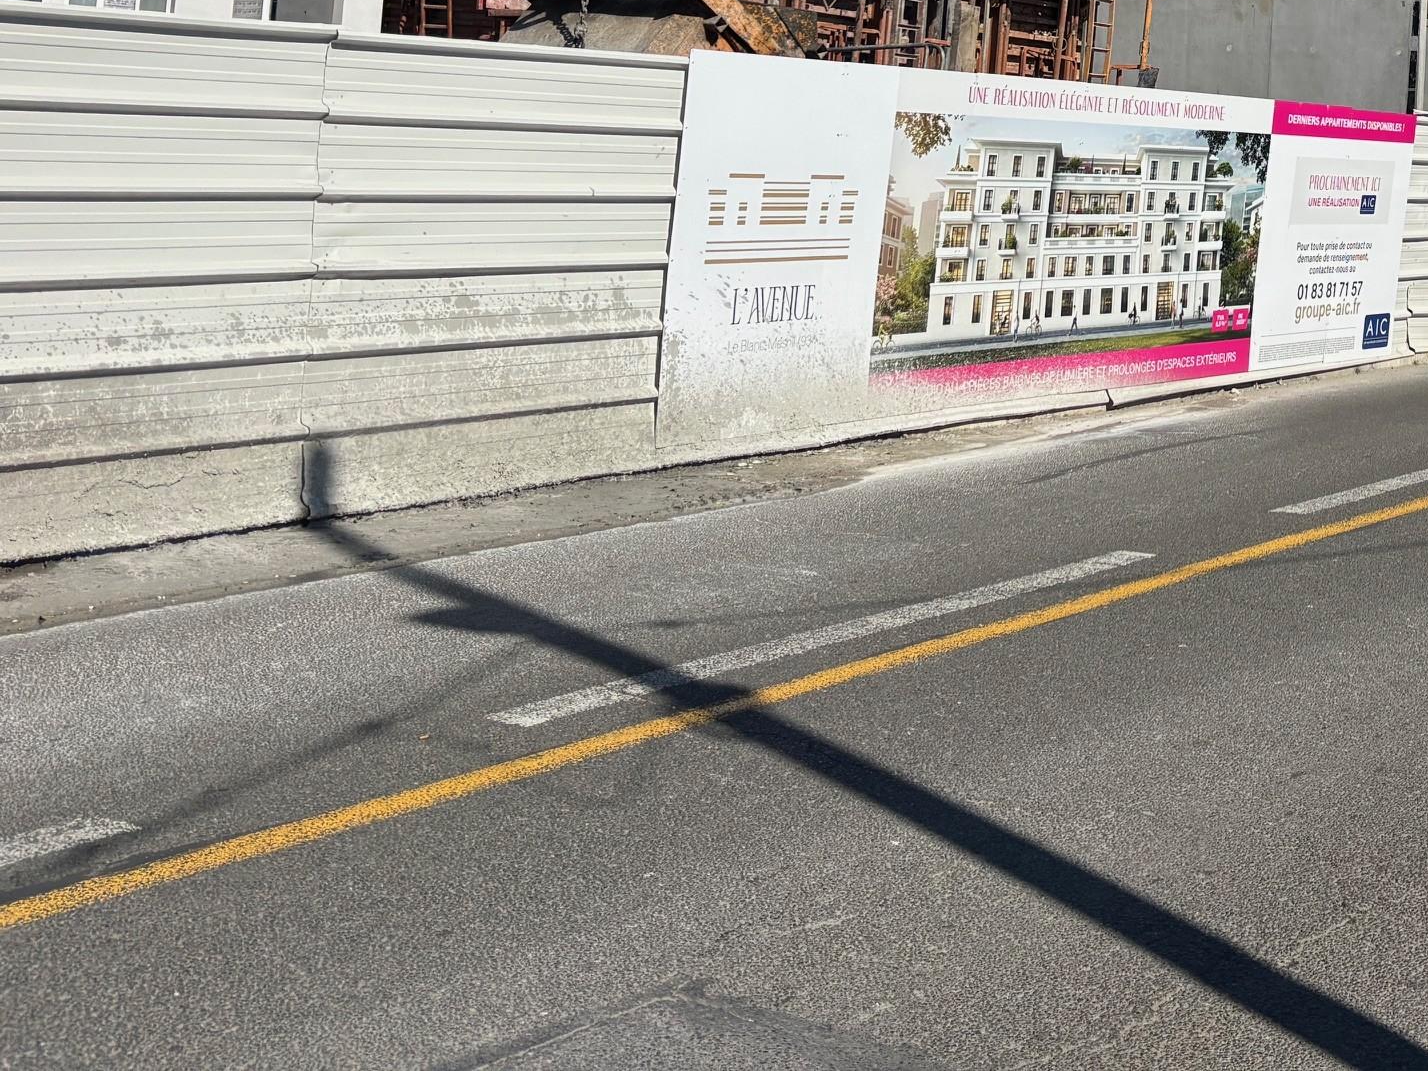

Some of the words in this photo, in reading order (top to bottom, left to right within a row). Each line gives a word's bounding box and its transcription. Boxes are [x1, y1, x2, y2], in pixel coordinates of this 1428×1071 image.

[968, 86, 990, 105] UNE
[993, 85, 1057, 110] RÉALISATION
[1059, 90, 1104, 113] ÉLÉGANTE
[1107, 97, 1119, 113] ET
[1121, 96, 1181, 118] RÉSOLUMENT
[1183, 102, 1226, 122] MODERNE
[1288, 114, 1320, 126] DERNIERS
[1320, 117, 1367, 130] APPARTEMENTS
[1367, 121, 1402, 132] DISPONIBLES
[1308, 174, 1369, 192] PROCHAINEMENT
[1370, 176, 1382, 192] ICI
[1308, 197, 1321, 208] UNE
[1322, 196, 1360, 208] RÉALISATION
[1361, 197, 1375, 208] AIC
[1296, 242, 1310, 252] Pour
[1310, 242, 1325, 251] toute
[1325, 241, 1339, 253] prise
[1338, 241, 1347, 250] de
[1346, 242, 1366, 250] contact
[1296, 254, 1323, 264] demande
[1323, 253, 1331, 263] de
[1308, 266, 1349, 275] contactez-nous
[1349, 266, 1357, 274] au
[1297, 283, 1309, 301] 01
[1310, 282, 1324, 299] 83
[1325, 281, 1337, 298] 81
[1339, 281, 1350, 297] 71
[1351, 280, 1363, 297] 57
[1294, 297, 1361, 324] groupe-aic.fr
[1365, 317, 1388, 337] AIC
[1096, 365, 1108, 379] ET
[1108, 358, 1156, 376] PROLONGÉS
[1157, 355, 1196, 371] D'ESPACES
[1196, 350, 1237, 367] EXTÉRIEURS
